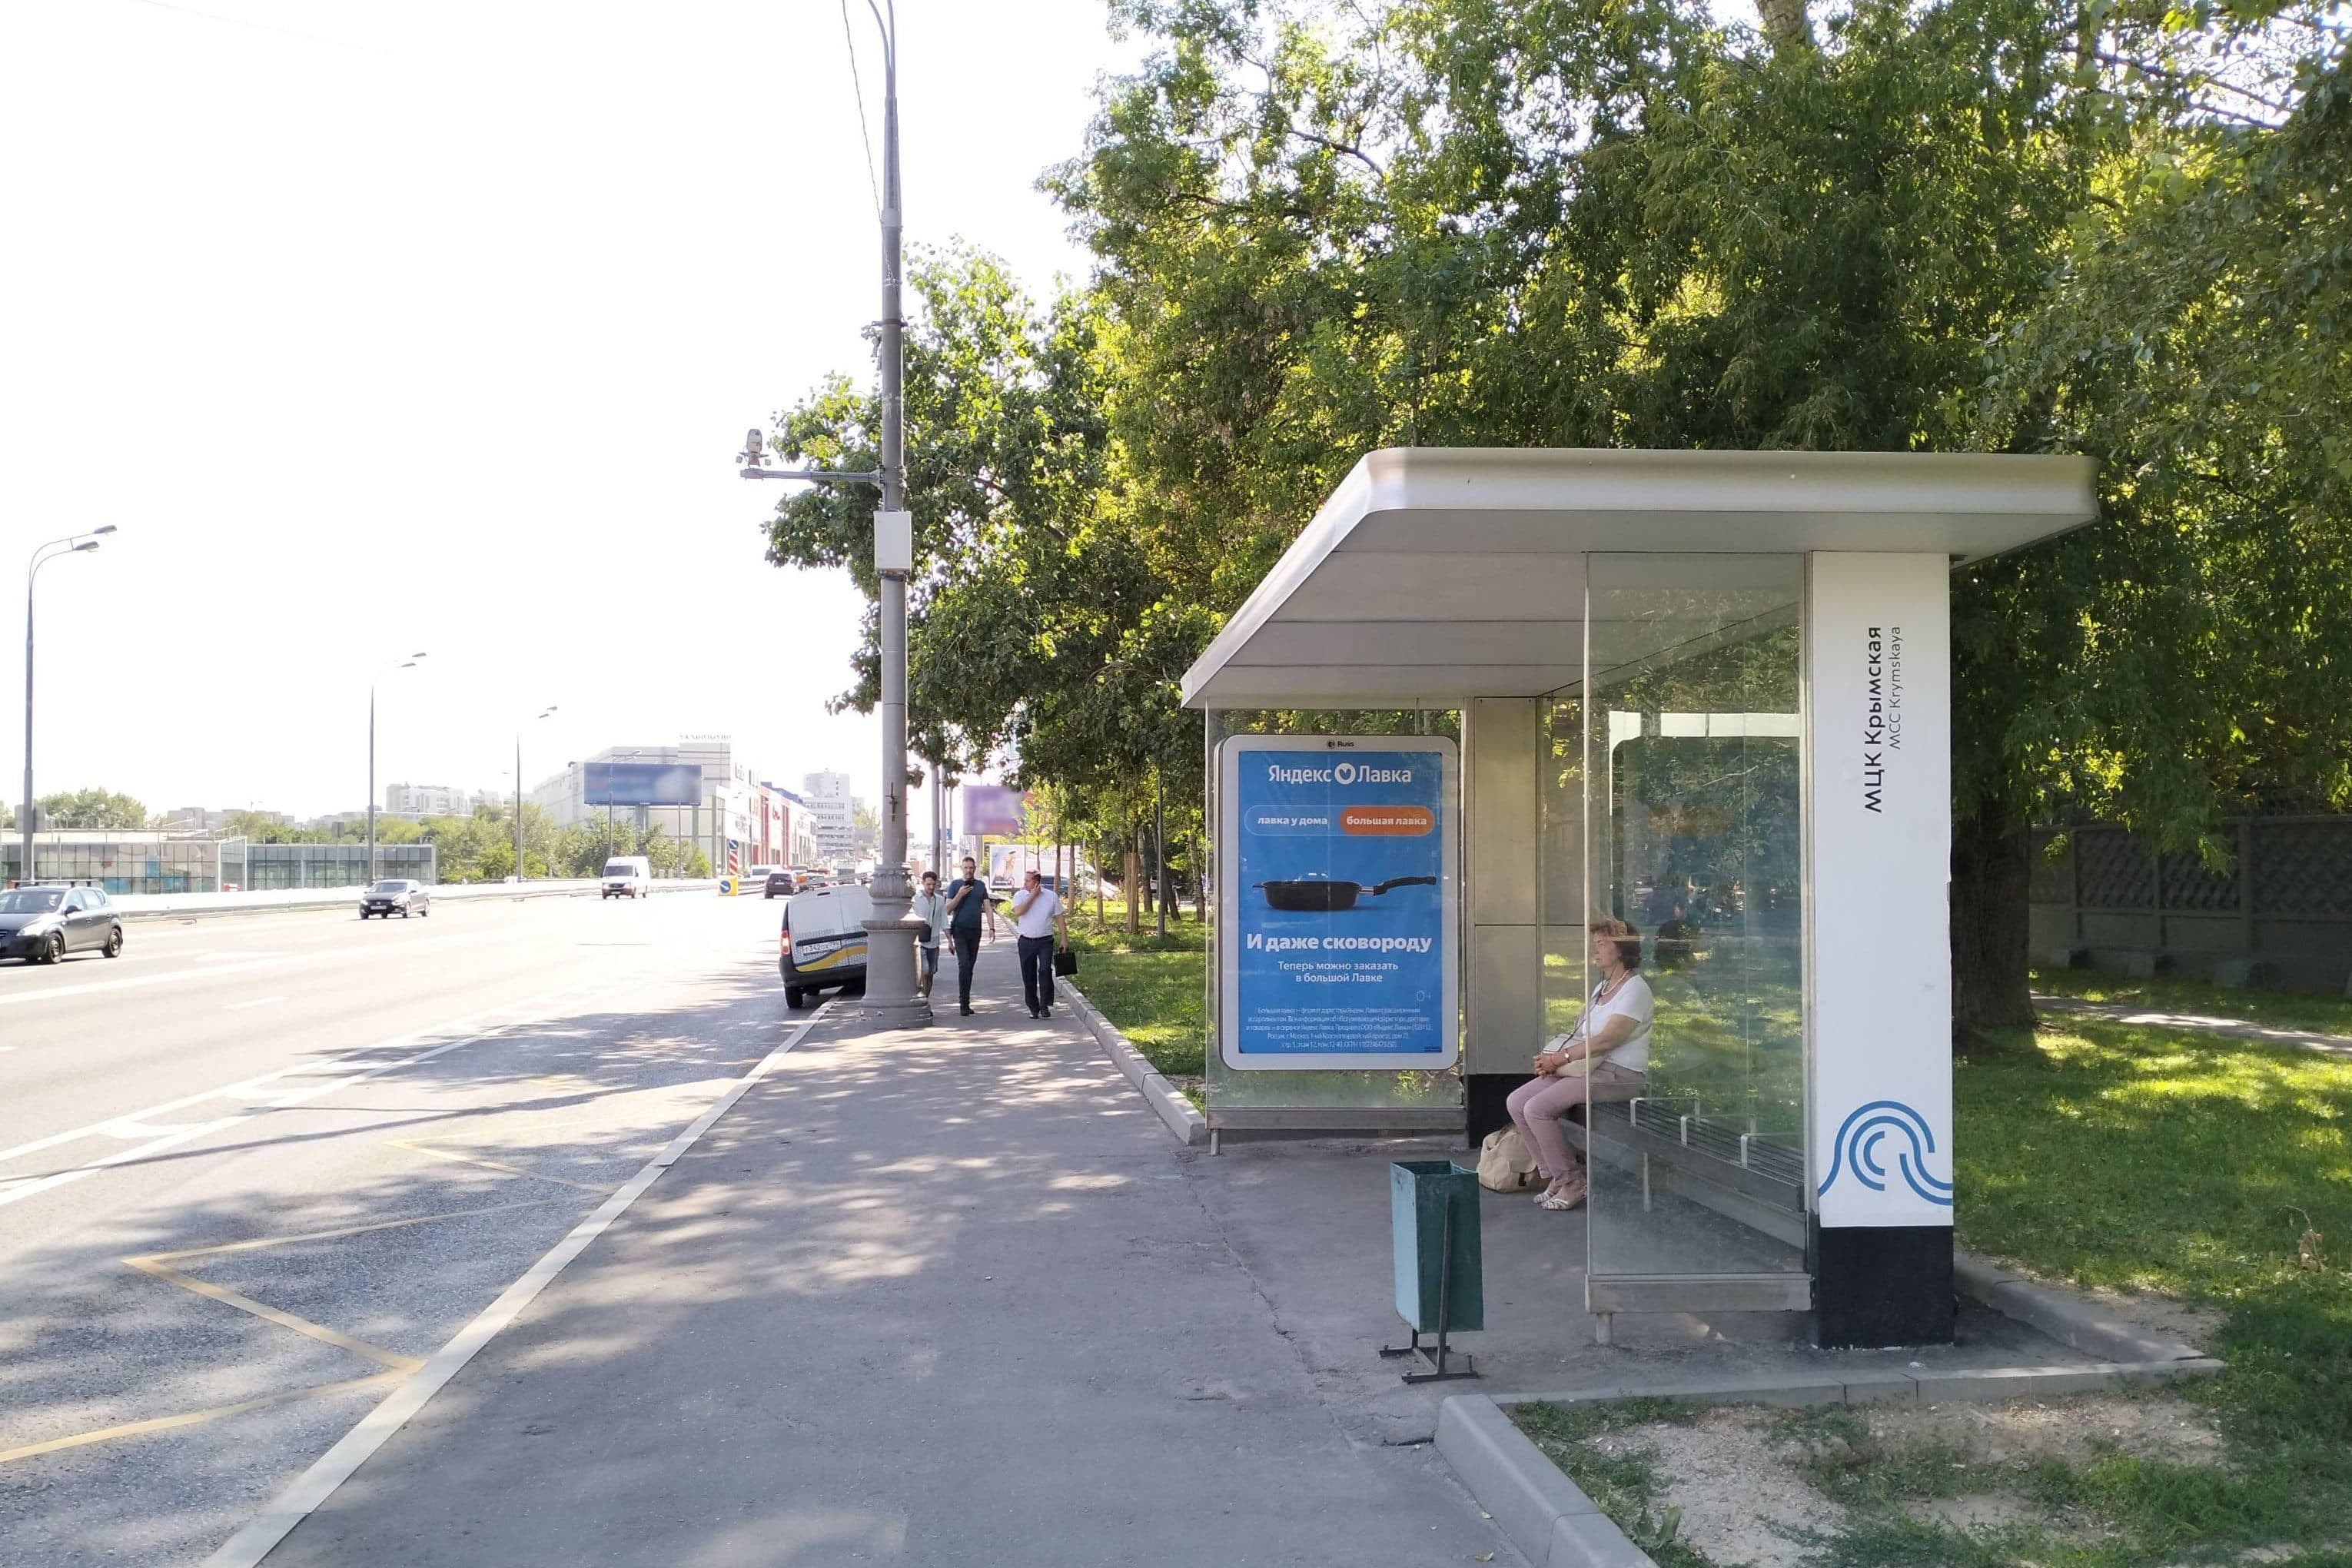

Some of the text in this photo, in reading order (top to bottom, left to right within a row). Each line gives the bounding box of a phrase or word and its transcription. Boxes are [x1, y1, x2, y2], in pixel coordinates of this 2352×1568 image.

[1888, 626, 1903, 750] MCC Krymskaya
[1864, 626, 1885, 813] МЦК Крымская
[1268, 765, 1412, 784] Яндекс Лавка
[1257, 817, 1328, 826] лавка у дома
[1347, 816, 1394, 826] большая
[1247, 933, 1432, 953] И даже сковороду
[1278, 961, 1399, 972] Теперь можно заказать
[1304, 972, 1350, 983] большой
[1353, 973, 1384, 983] Лавке
